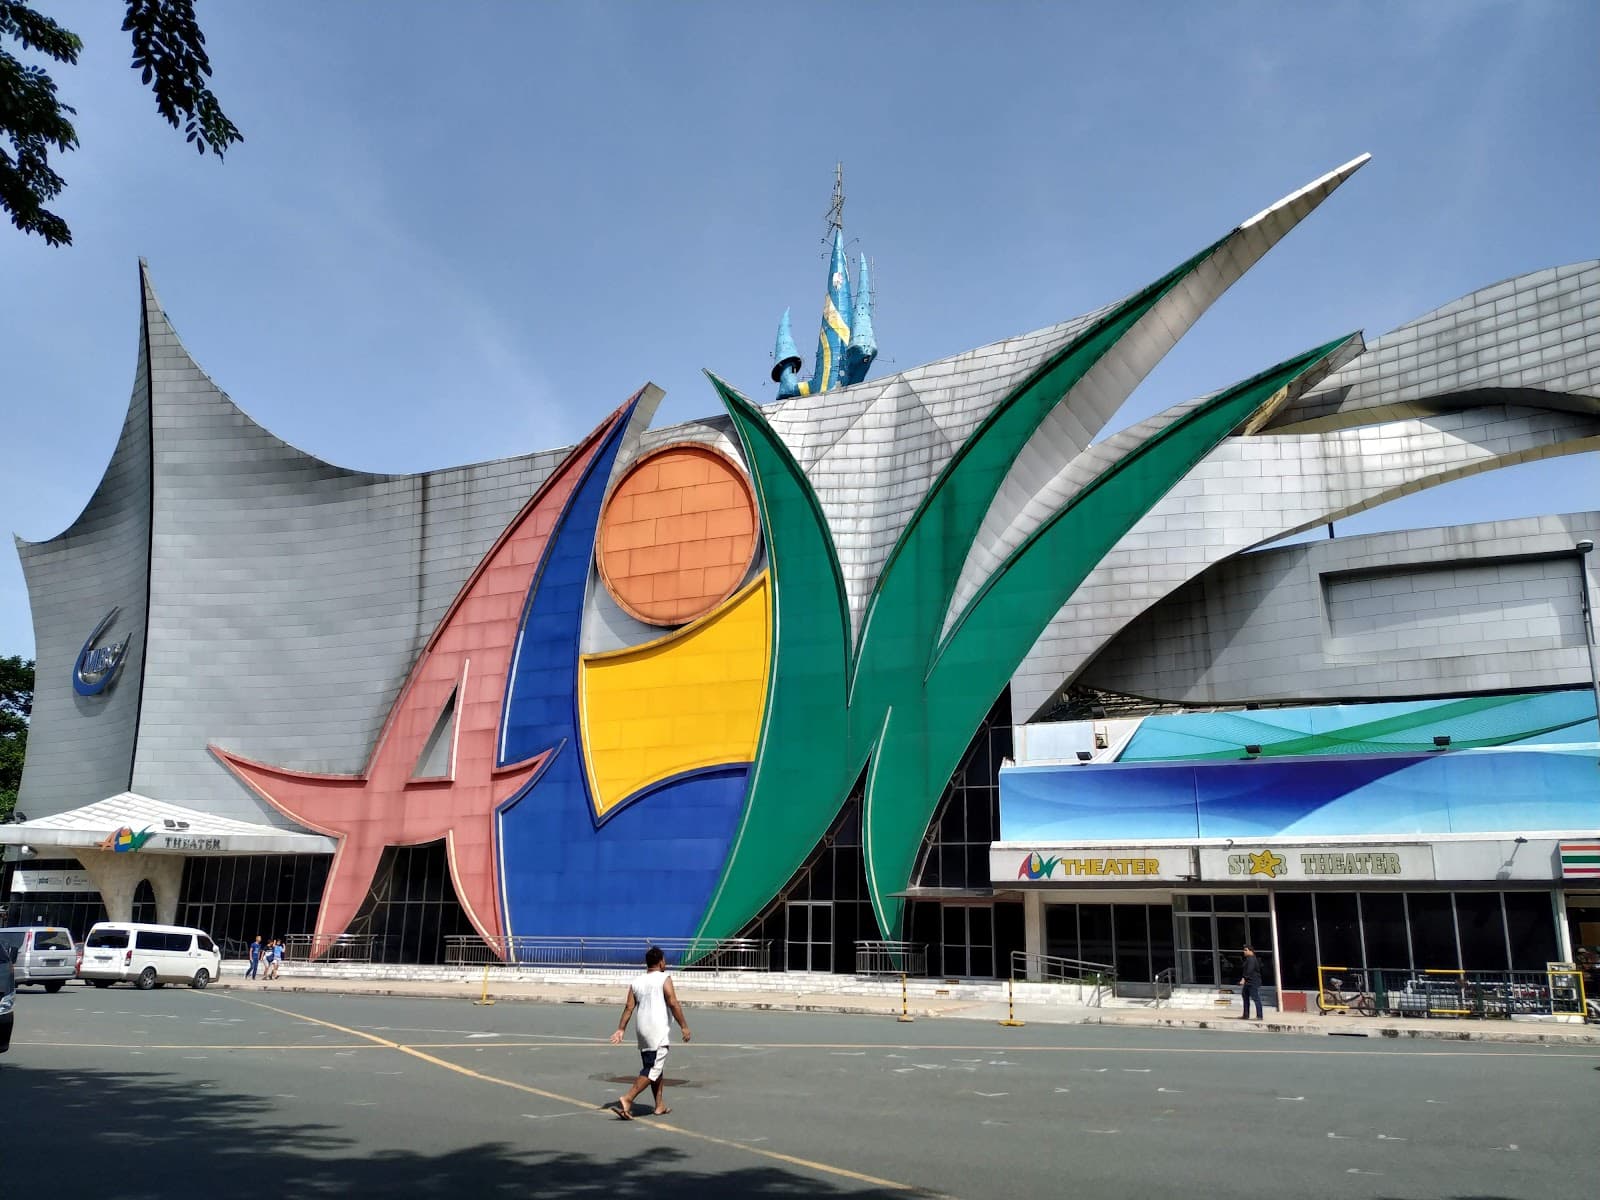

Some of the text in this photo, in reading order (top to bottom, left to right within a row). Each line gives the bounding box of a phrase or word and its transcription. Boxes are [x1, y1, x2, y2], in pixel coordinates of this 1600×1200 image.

[164, 836, 222, 851] THEATER
[1061, 858, 1160, 876] THEATER
[1228, 850, 1402, 878] STR THEATER
